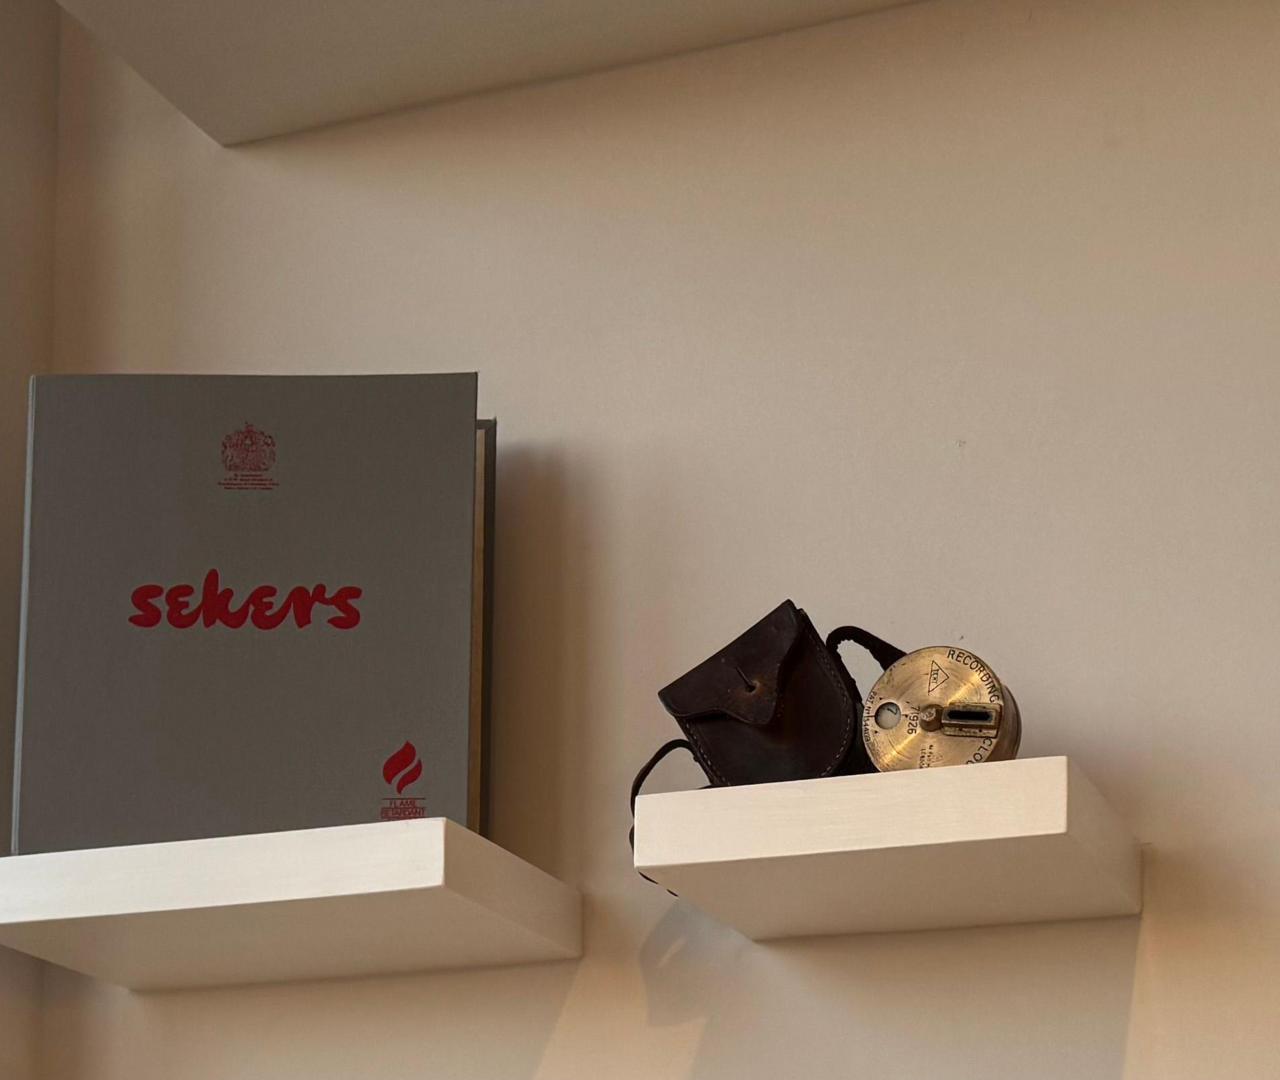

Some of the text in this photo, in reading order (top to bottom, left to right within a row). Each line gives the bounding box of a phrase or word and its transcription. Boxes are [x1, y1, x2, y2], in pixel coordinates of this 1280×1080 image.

[128, 568, 363, 630] sekers
[947, 649, 1001, 765] RECORDING CLO
